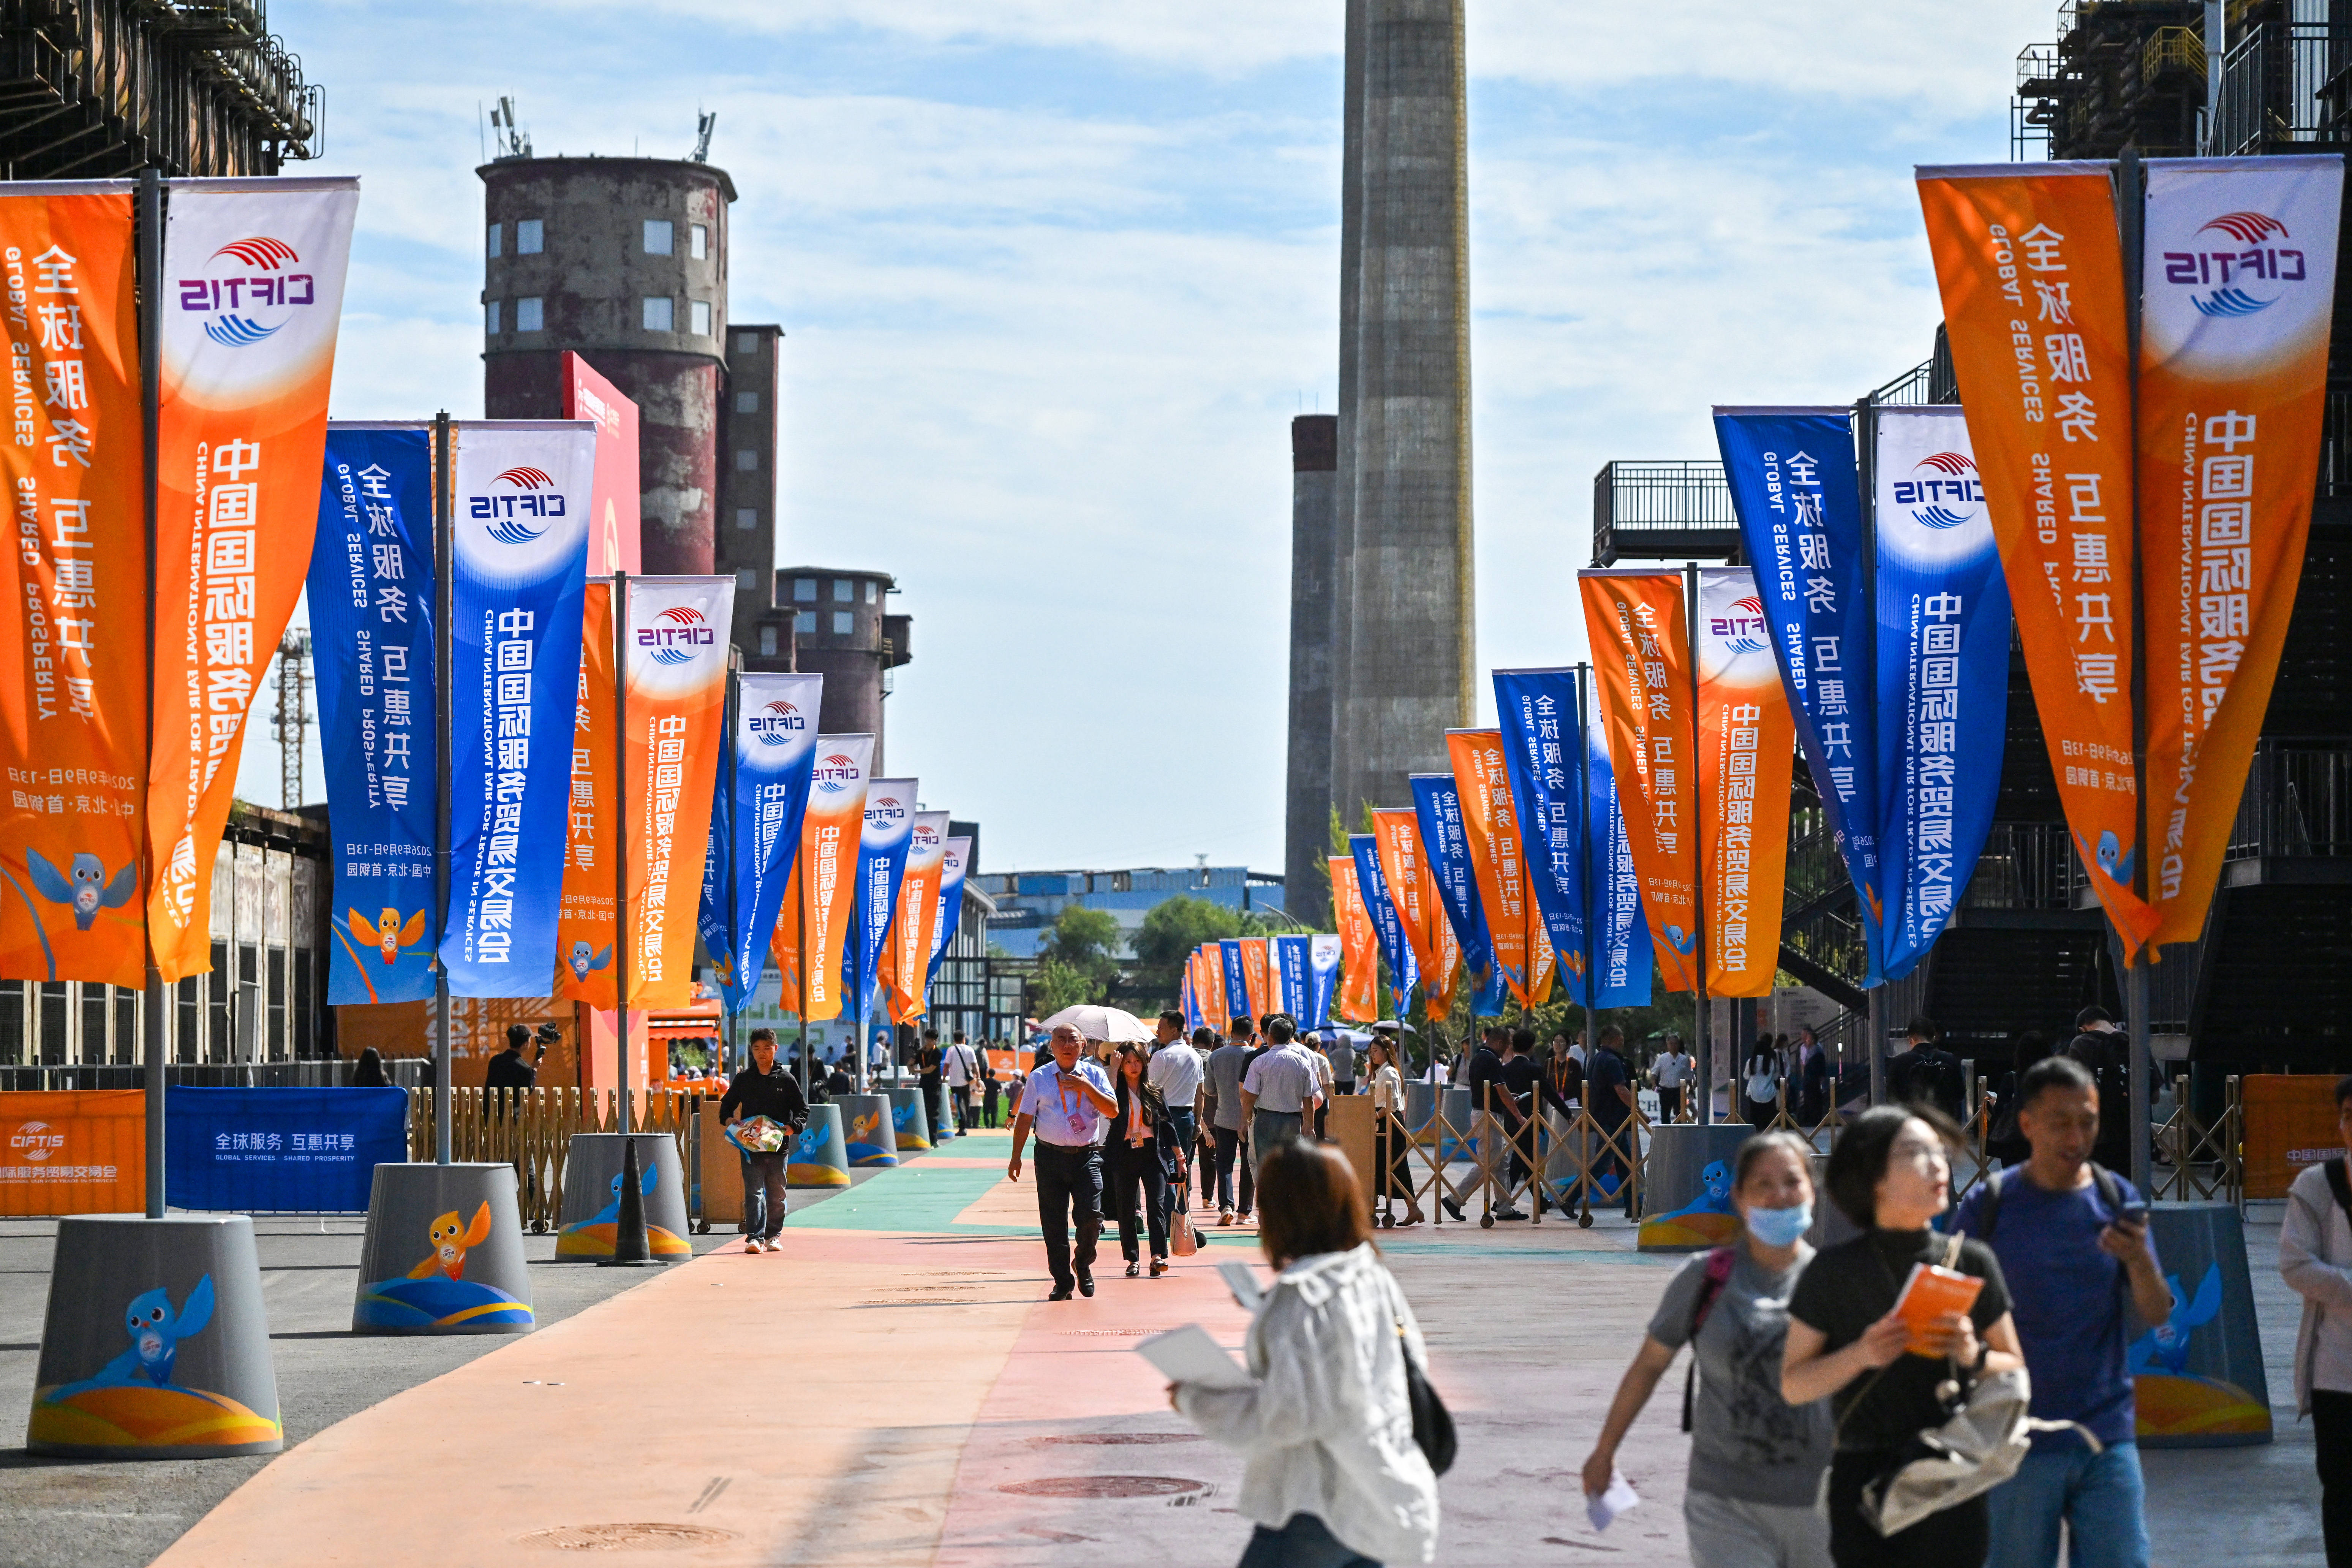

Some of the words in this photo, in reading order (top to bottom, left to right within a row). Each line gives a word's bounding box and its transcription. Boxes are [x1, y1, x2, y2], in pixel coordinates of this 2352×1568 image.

[10, 1135, 64, 1147] CIFTIS
[215, 1133, 283, 1151] 全球服务
[292, 1134, 354, 1151] 互惠共享
[0, 1165, 117, 1178] 际服务贸易交易会
